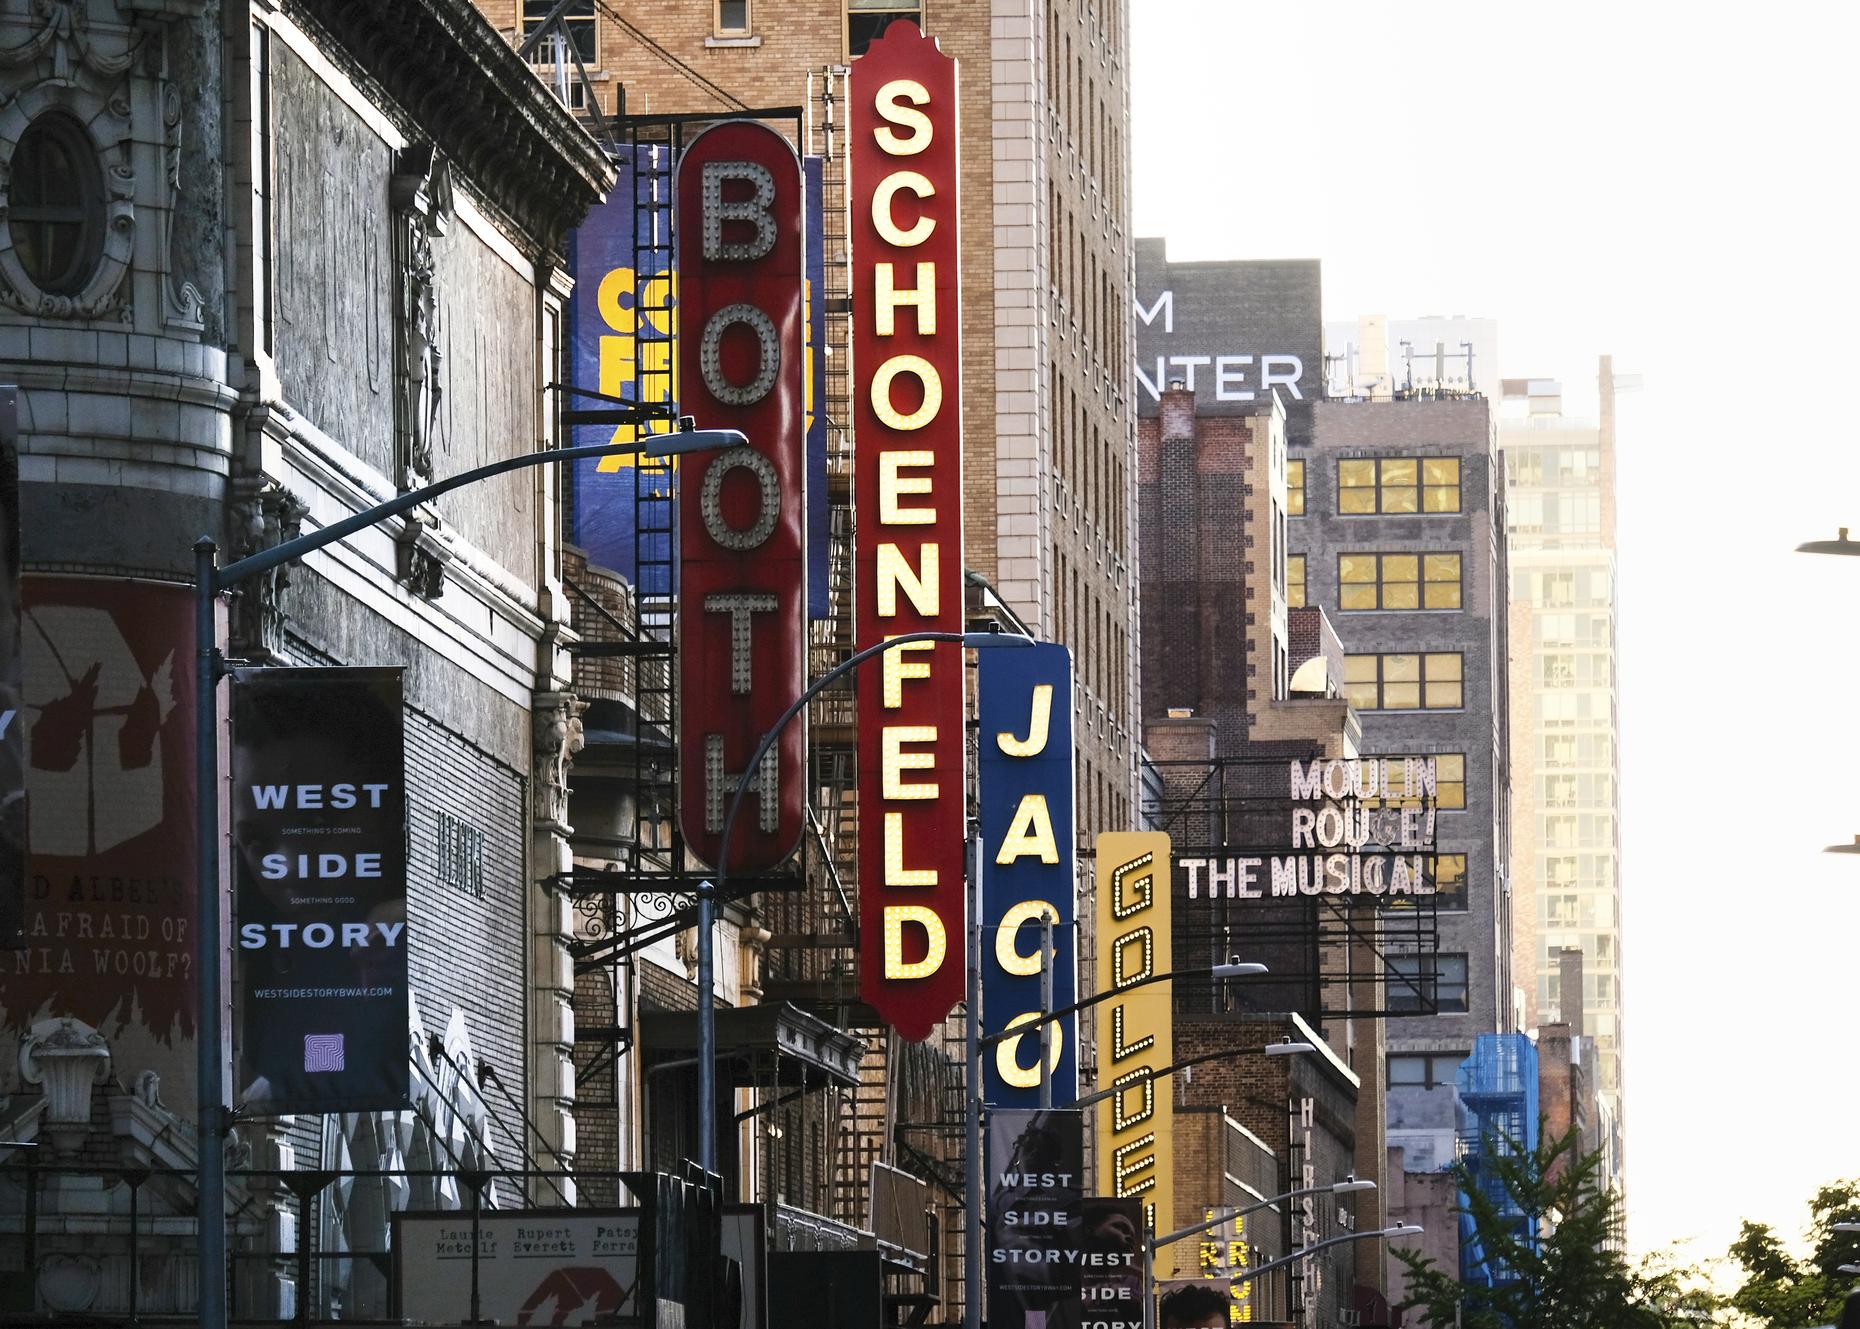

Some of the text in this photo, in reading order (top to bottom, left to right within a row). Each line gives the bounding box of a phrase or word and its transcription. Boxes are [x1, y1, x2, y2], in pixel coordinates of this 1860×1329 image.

[700, 161, 781, 834] BOOTH
[871, 79, 947, 980] SCHOENFELD
[1290, 757, 1436, 800] MOULIN
[251, 783, 389, 810] WEST
[1292, 806, 1436, 848] ROUGE!
[261, 853, 382, 879] SIDE
[1179, 854, 1436, 899] THE MUSICAL
[995, 684, 1063, 1089] JACO
[30, 911, 188, 942] AFRAID OF
[240, 922, 405, 949] STORY
[93, 948, 192, 980] WOOLF?
[254, 987, 392, 999] WESTSIDESTORYBWAY.COM
[1000, 1173, 1072, 1188] WEST
[1004, 1210, 1068, 1226] SIDE
[517, 1227, 571, 1241] Rupert
[597, 1226, 639, 1240] Patsy
[436, 1242, 497, 1254] Metclf
[513, 1241, 576, 1253] Everett
[992, 1248, 1079, 1264] STORY
